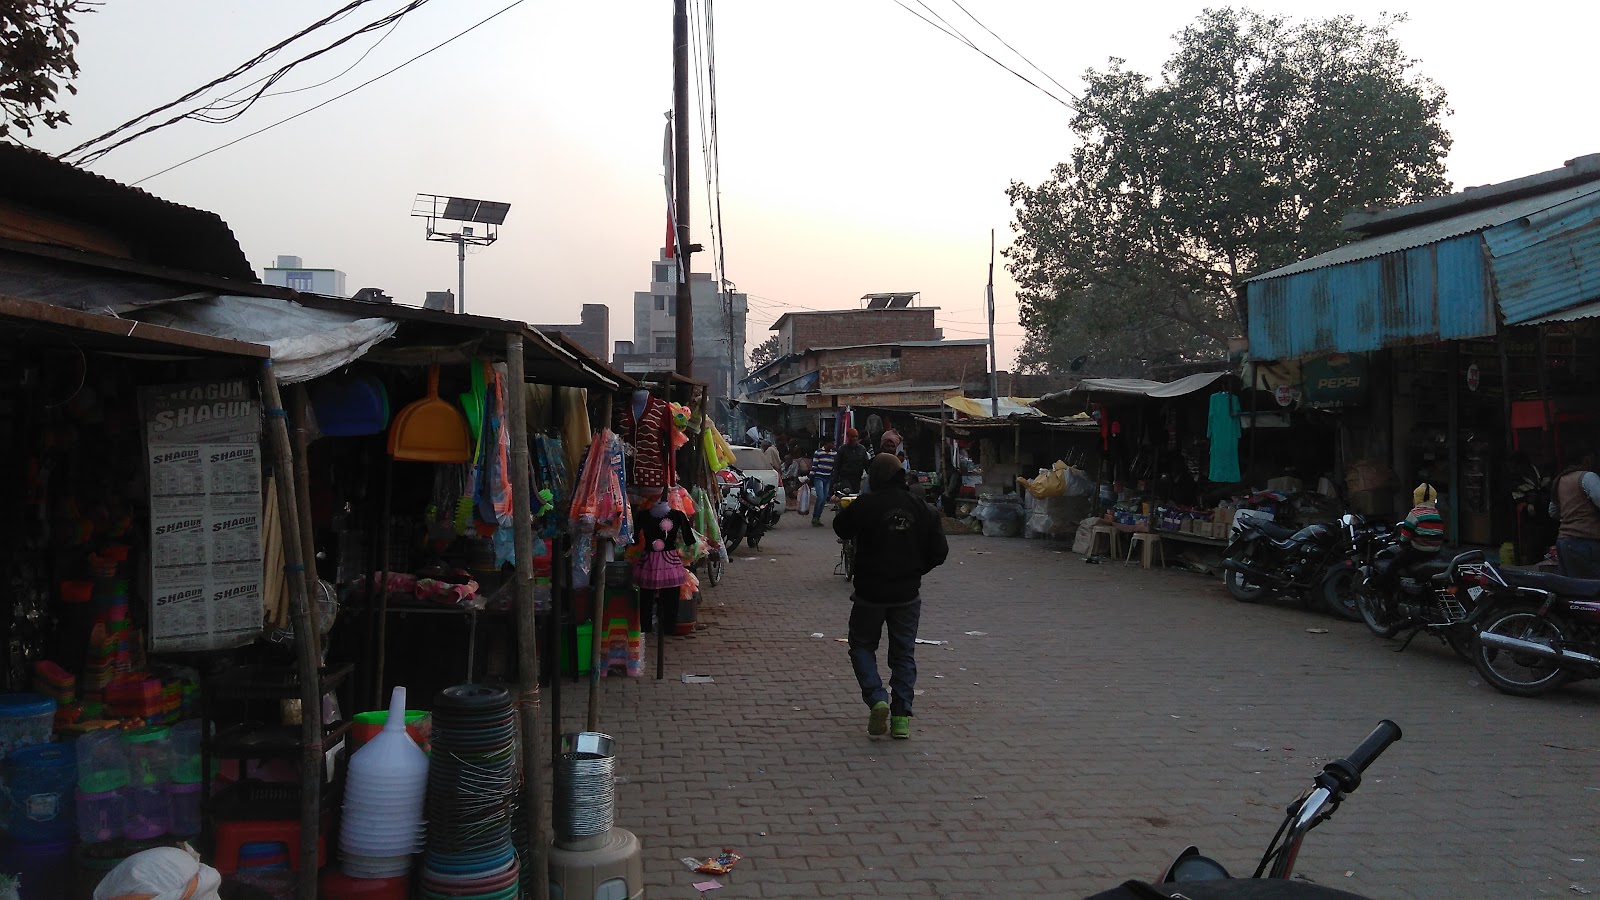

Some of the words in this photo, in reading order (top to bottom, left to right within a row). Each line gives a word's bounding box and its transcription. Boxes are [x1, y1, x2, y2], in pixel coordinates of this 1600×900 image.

[154, 380, 243, 400] AGUN
[1318, 377, 1361, 389] PEPSI
[153, 401, 251, 433] SHAGUN
[154, 449, 199, 464] SHAGUN
[210, 449, 254, 463] SHAGUN
[155, 519, 202, 535] SHAGUN
[212, 516, 256, 532] SHAGUN
[157, 589, 203, 606] SHAGUN
[213, 584, 258, 601] SHAGUN
